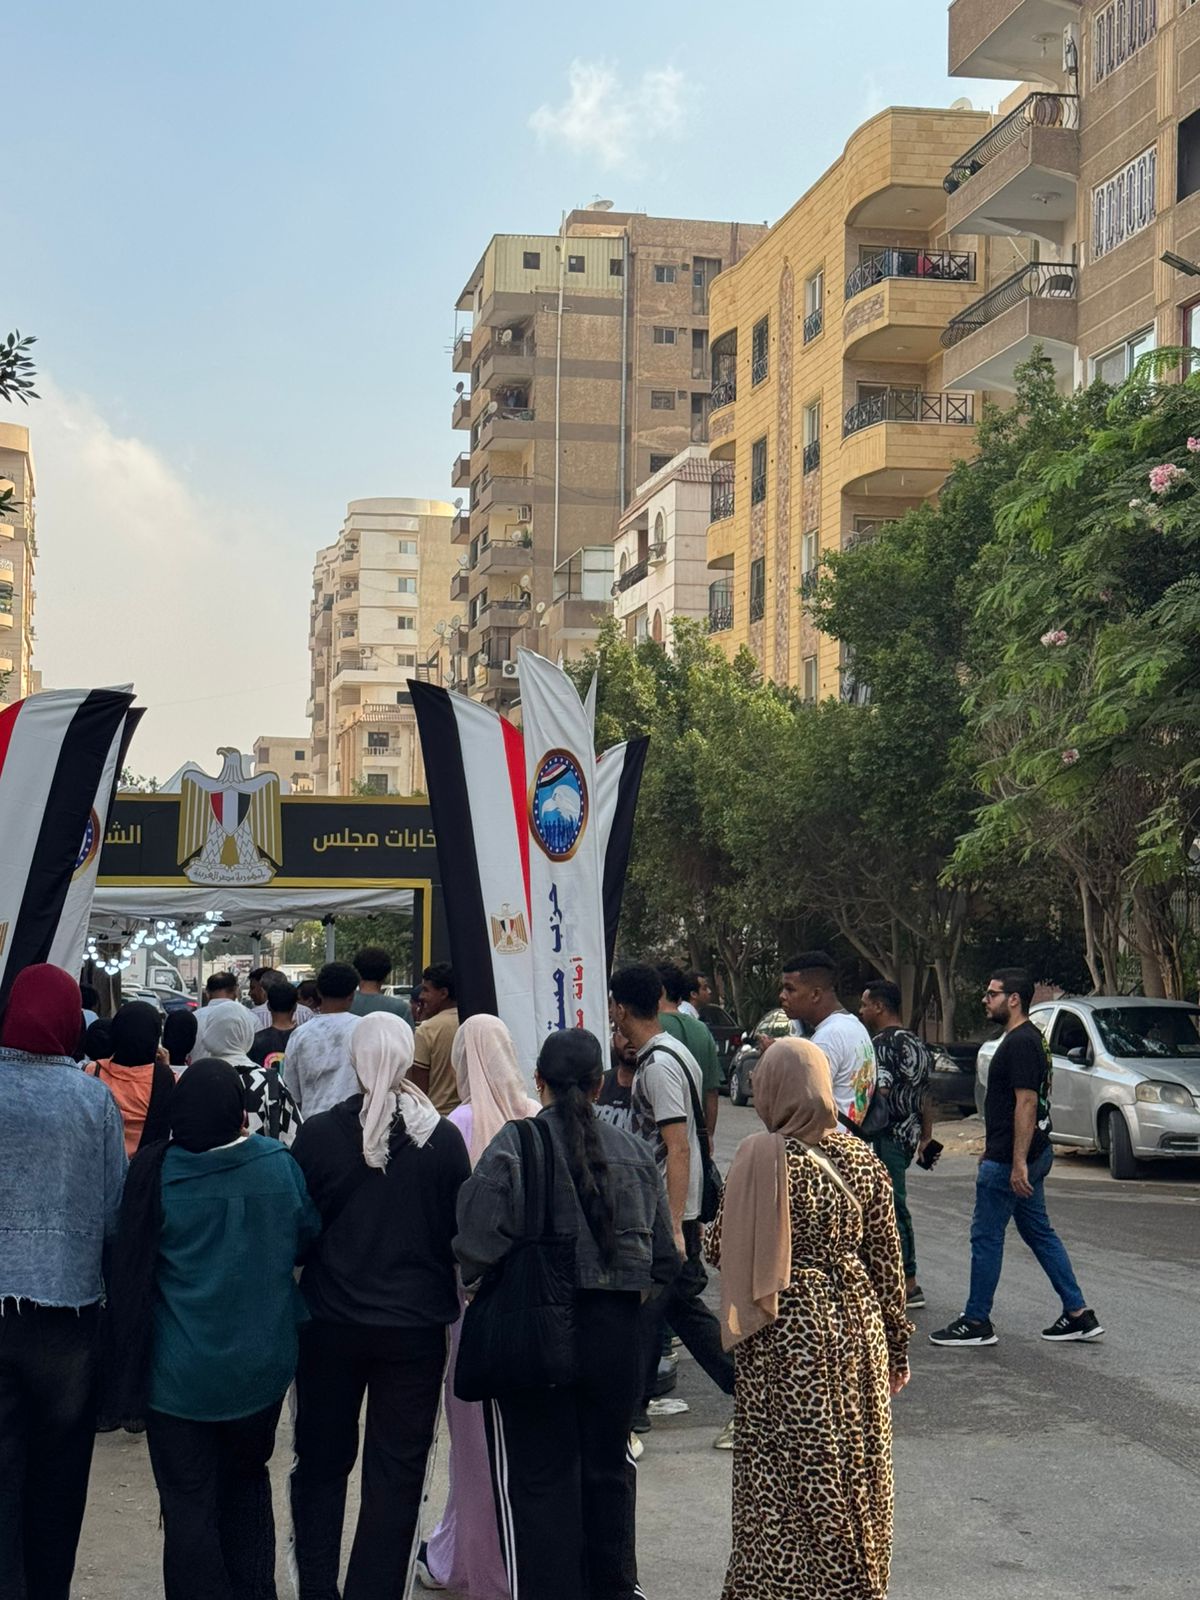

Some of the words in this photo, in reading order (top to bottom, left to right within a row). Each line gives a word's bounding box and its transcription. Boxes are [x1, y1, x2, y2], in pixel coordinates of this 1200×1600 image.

[105, 821, 141, 844] الش
[313, 827, 379, 852] مجلس
[385, 828, 437, 852] خابات
[549, 882, 563, 953] حزب
[570, 956, 584, 1000] أمانة
[547, 968, 566, 1030] مست
